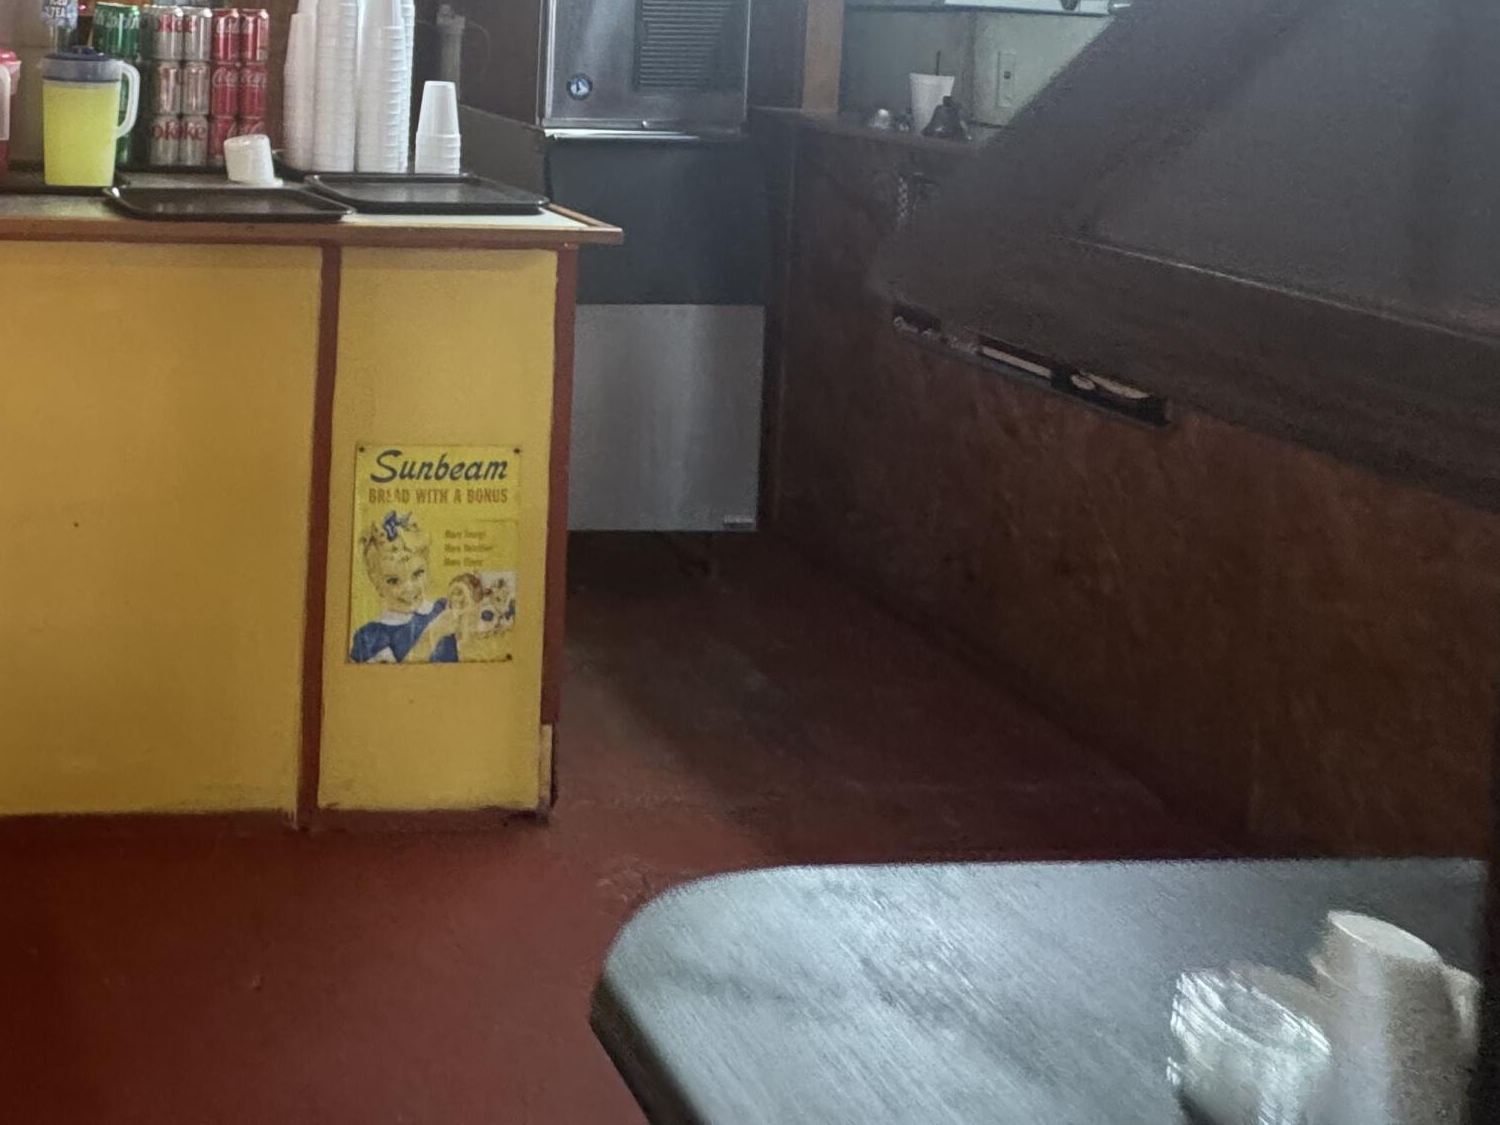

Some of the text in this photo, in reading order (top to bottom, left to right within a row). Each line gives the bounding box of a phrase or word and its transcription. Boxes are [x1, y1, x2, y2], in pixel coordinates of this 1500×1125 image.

[370, 449, 508, 483] Sunbeam
[415, 488, 448, 504] WITH
[453, 488, 462, 504] A
[467, 488, 508, 504] BONUS
